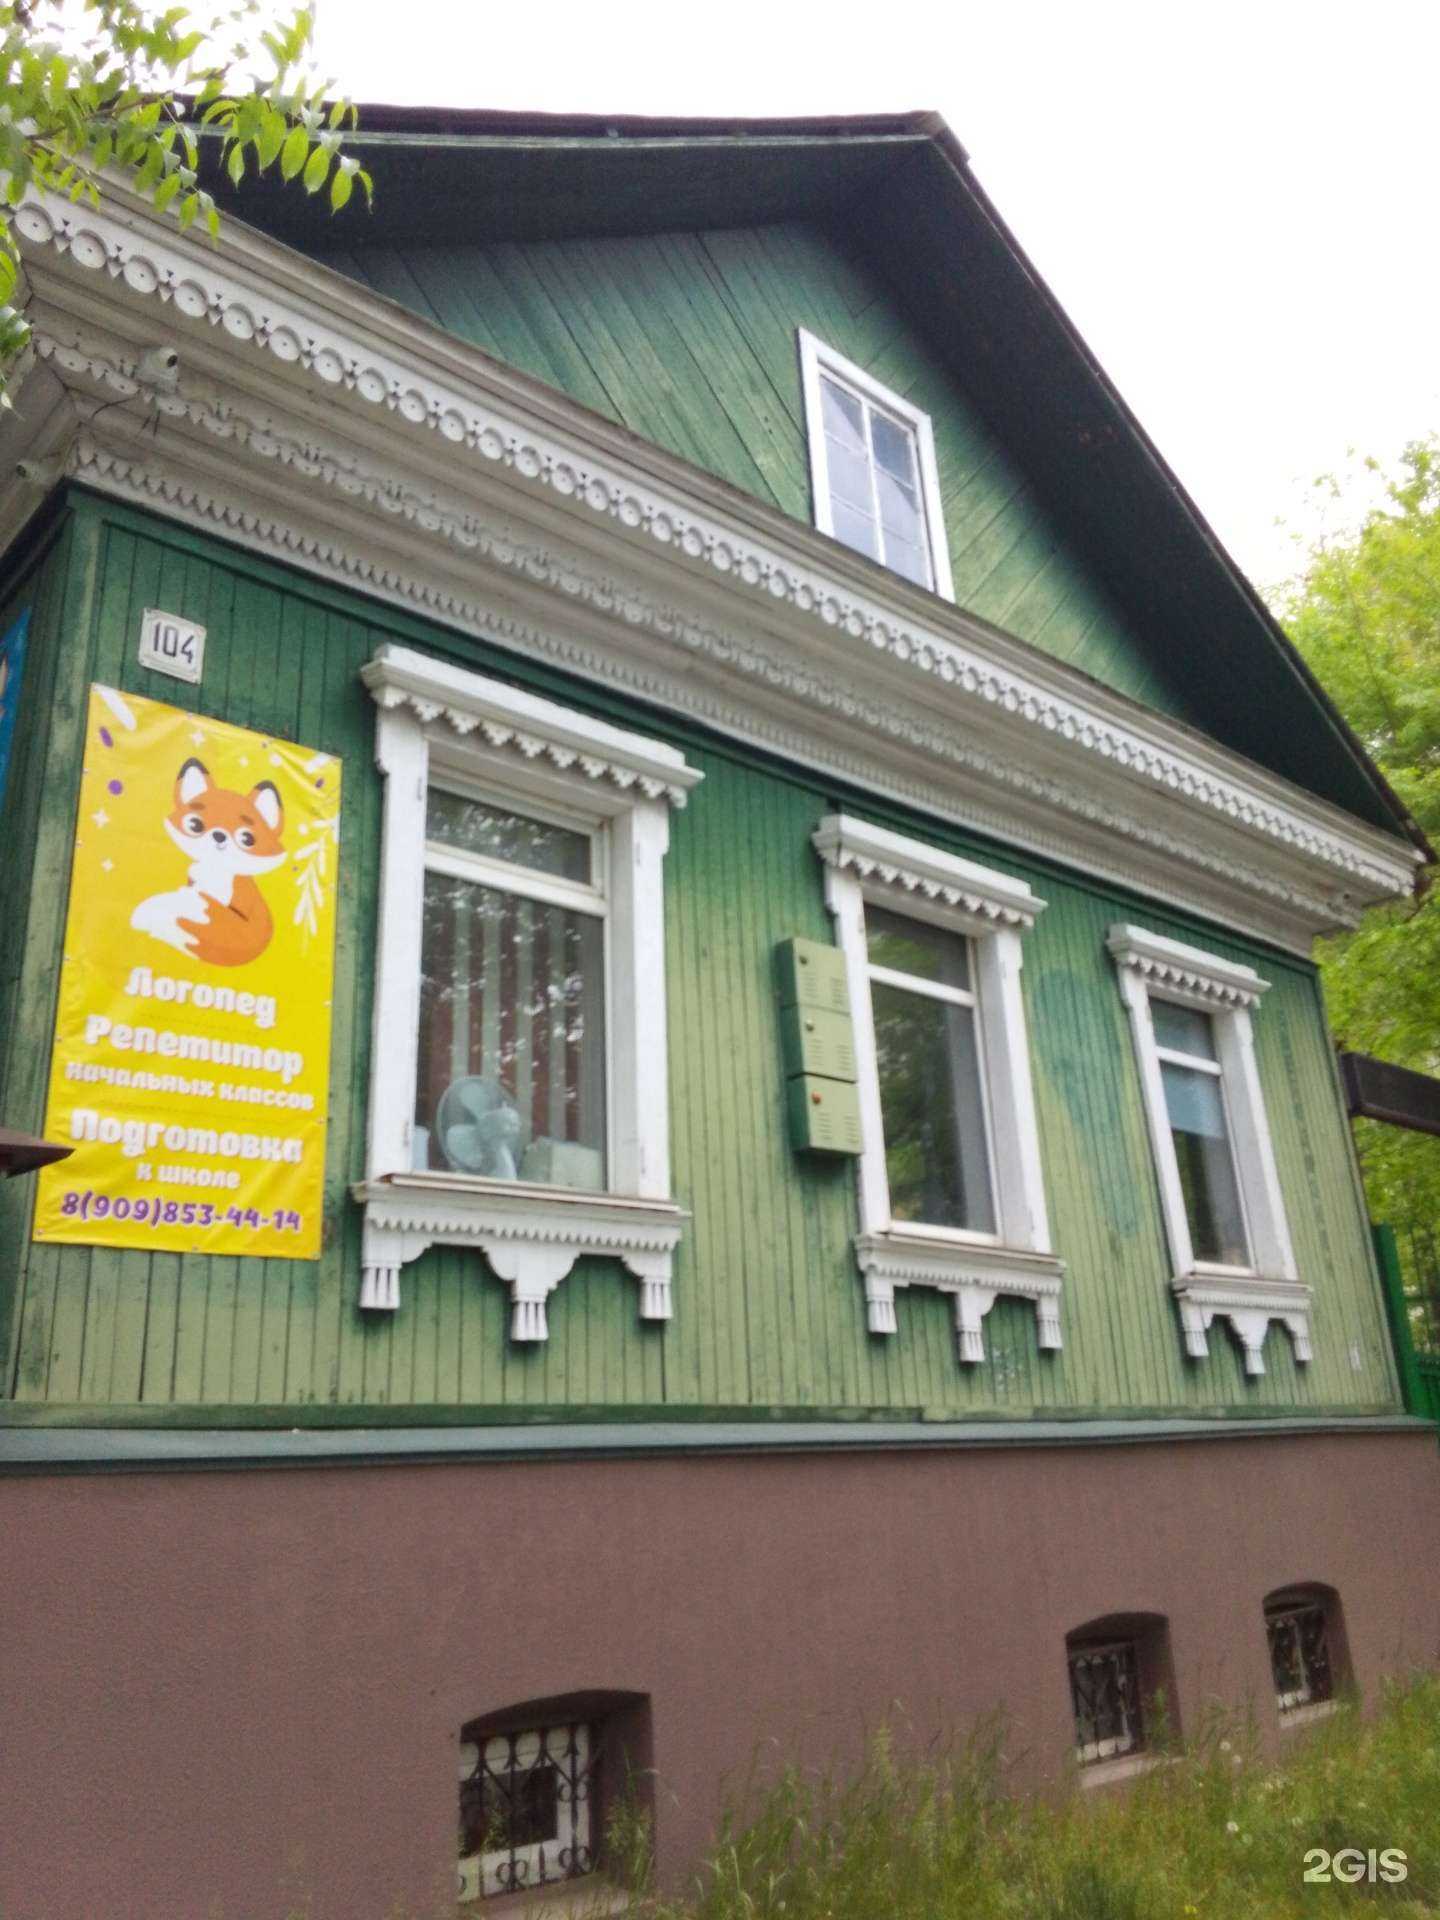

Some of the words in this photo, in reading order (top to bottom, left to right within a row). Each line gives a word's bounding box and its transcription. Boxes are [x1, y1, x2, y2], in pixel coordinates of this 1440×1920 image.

[153, 621, 194, 664] 104
[125, 966, 276, 1028] Логопед
[84, 1014, 304, 1084] Репетитор
[65, 1061, 214, 1096] начальных
[218, 1082, 314, 1111] классов
[70, 1108, 302, 1162] Подготовка
[158, 1164, 241, 1189] школе
[61, 1191, 301, 1232] 8(909)853-44-14
